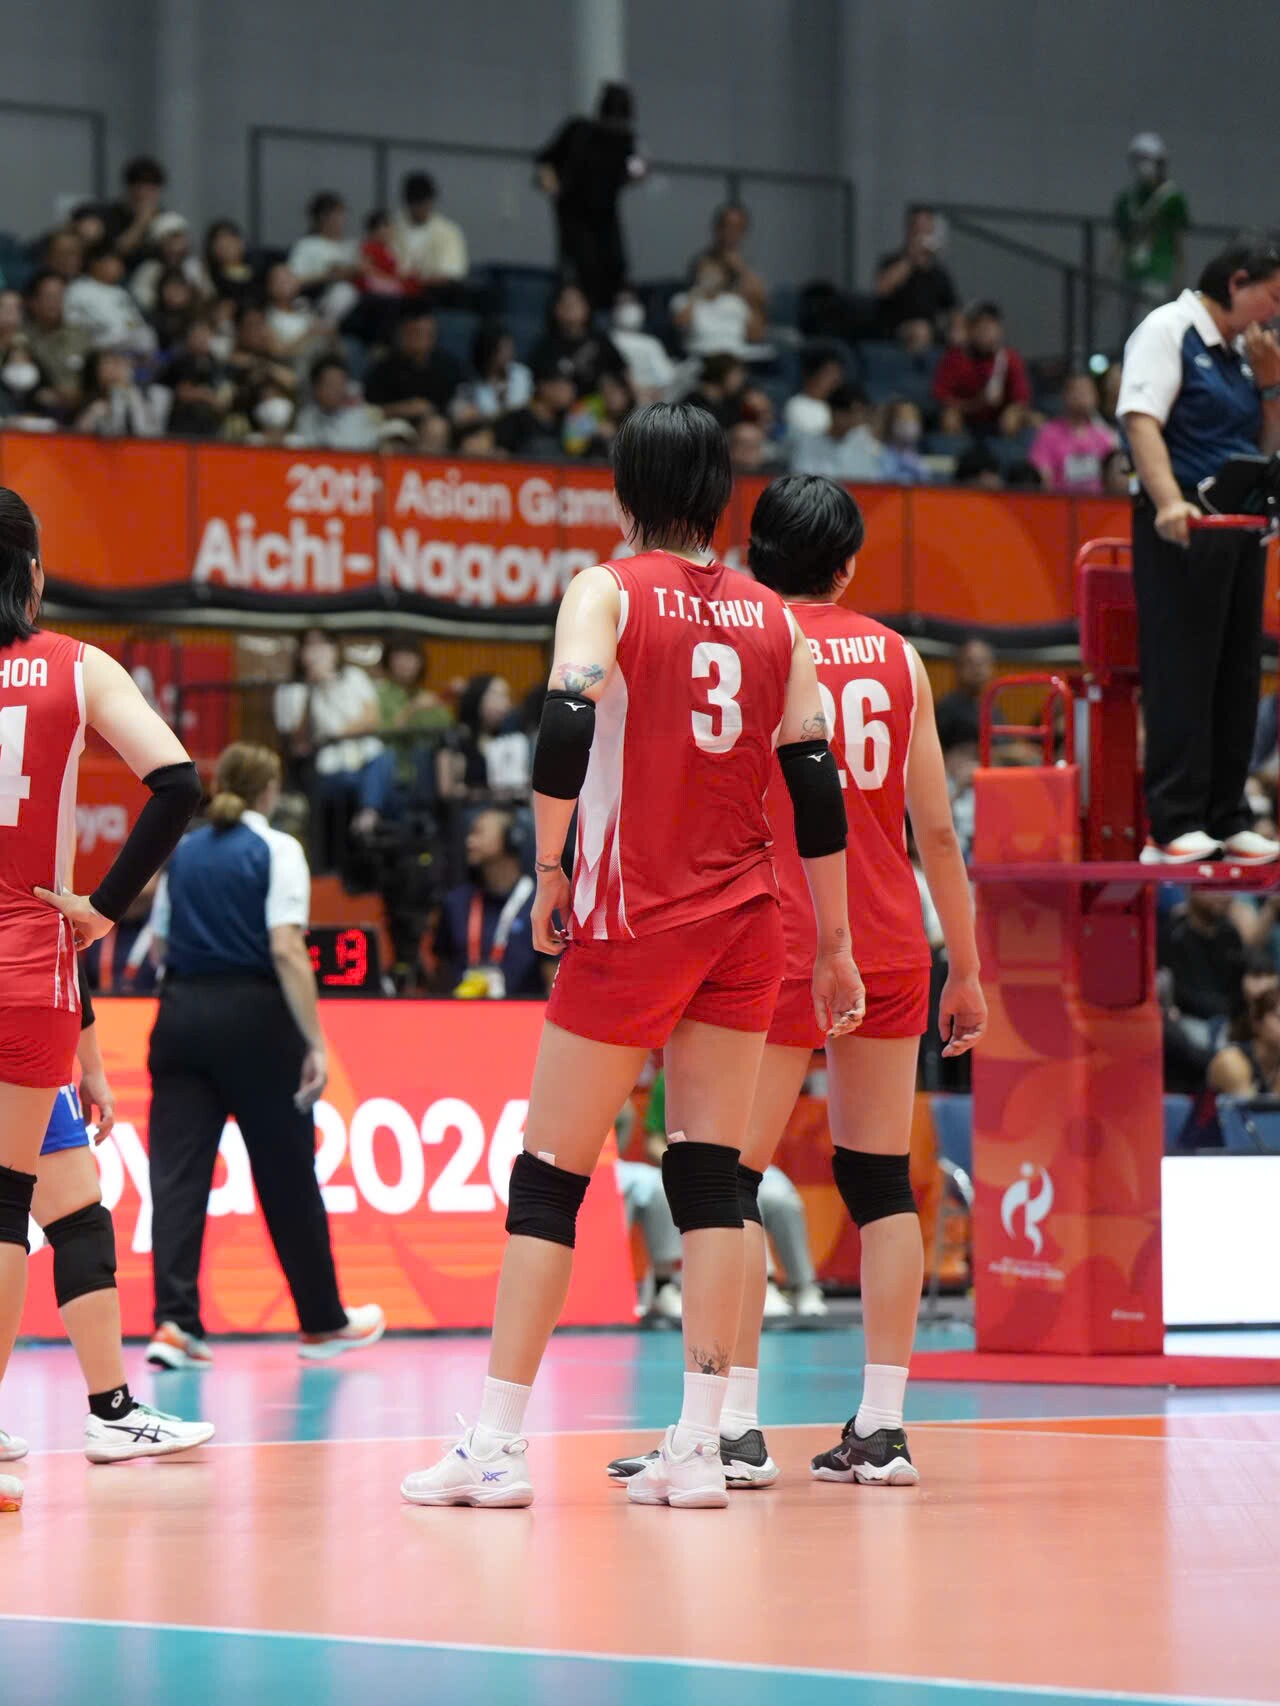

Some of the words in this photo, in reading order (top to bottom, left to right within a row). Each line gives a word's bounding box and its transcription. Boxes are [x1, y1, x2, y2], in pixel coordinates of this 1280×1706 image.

[395, 468, 514, 523] Asian
[518, 477, 618, 529] Gam
[691, 641, 743, 754] 3
